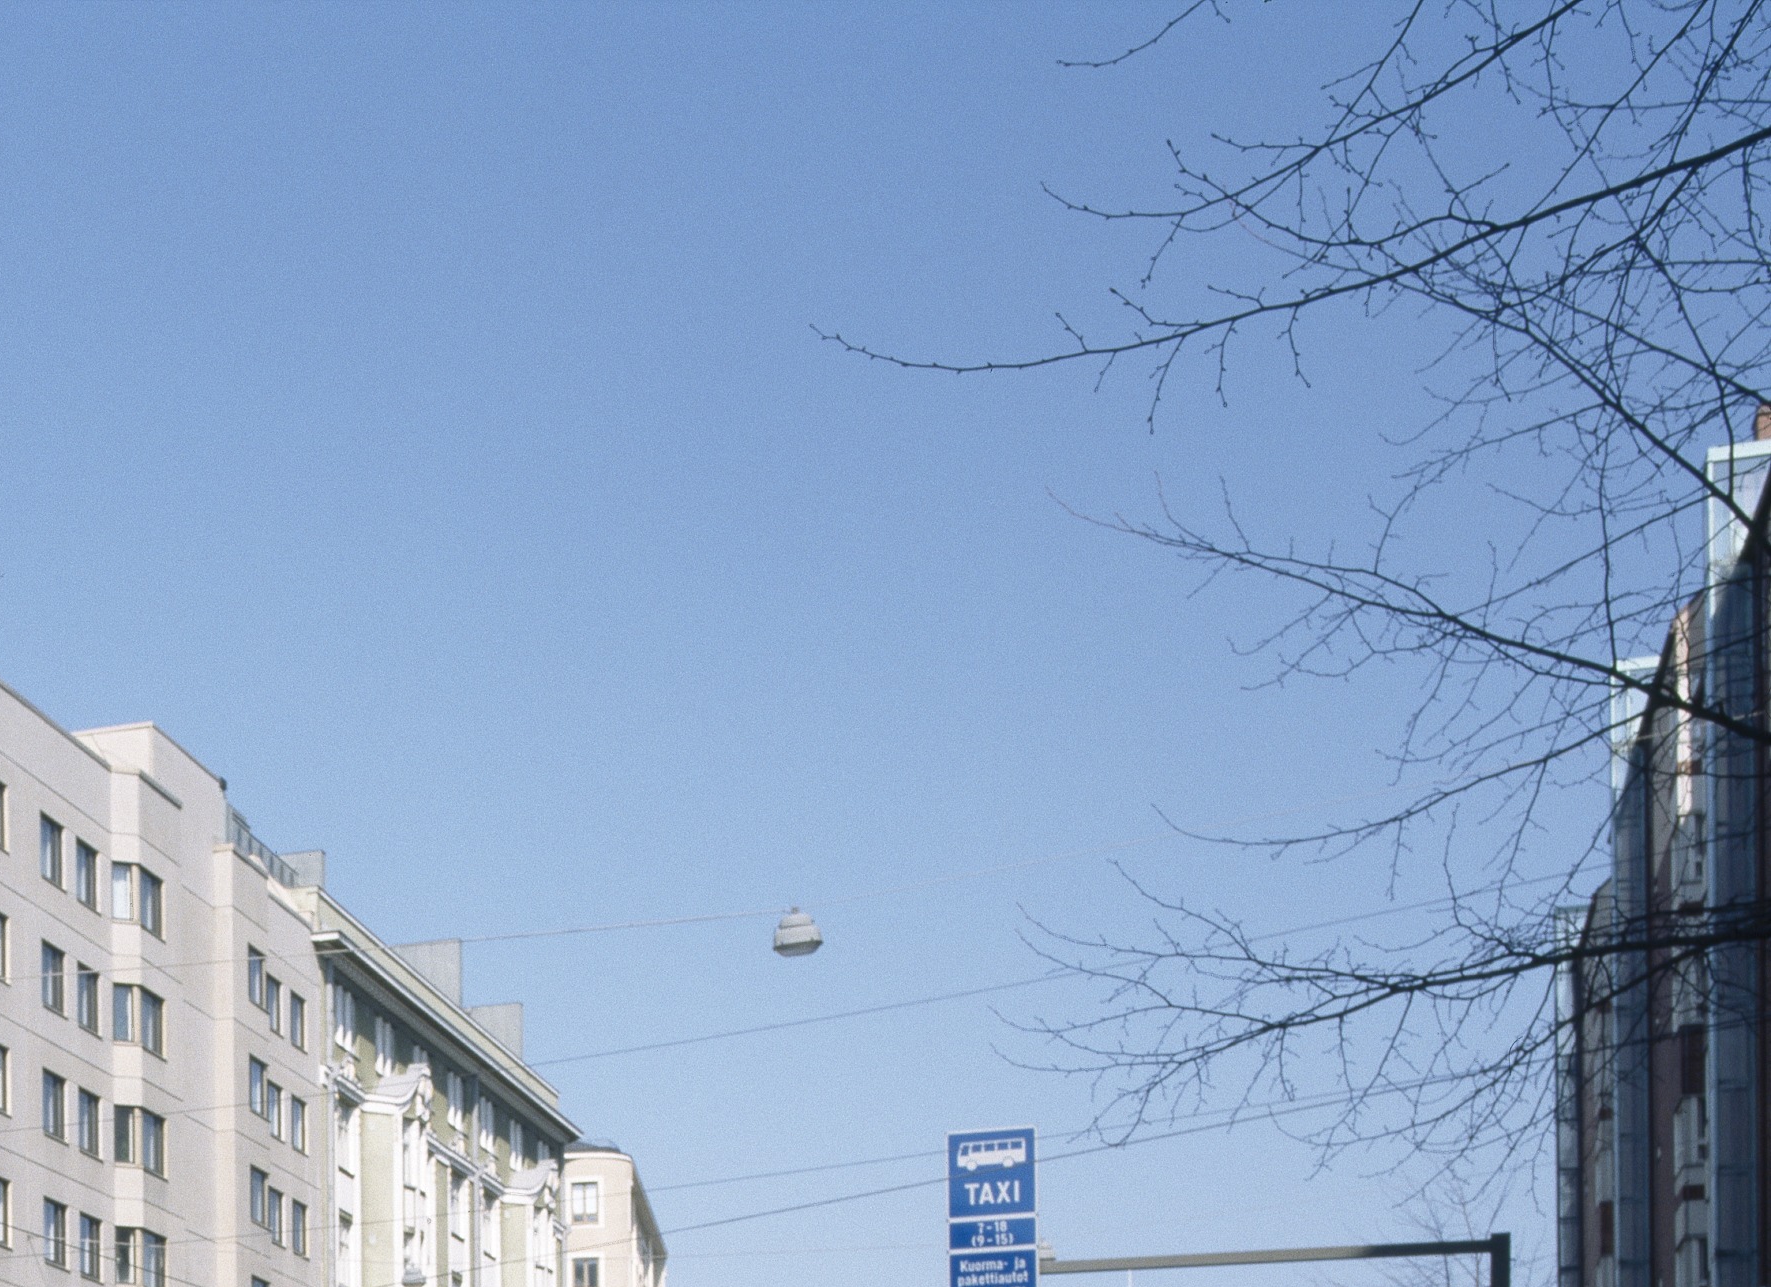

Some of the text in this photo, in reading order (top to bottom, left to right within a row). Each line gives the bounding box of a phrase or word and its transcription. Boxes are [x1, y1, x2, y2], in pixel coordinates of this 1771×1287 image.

[964, 1179, 1021, 1206] TAXI
[959, 1256, 1026, 1273] Kuorma- ja
